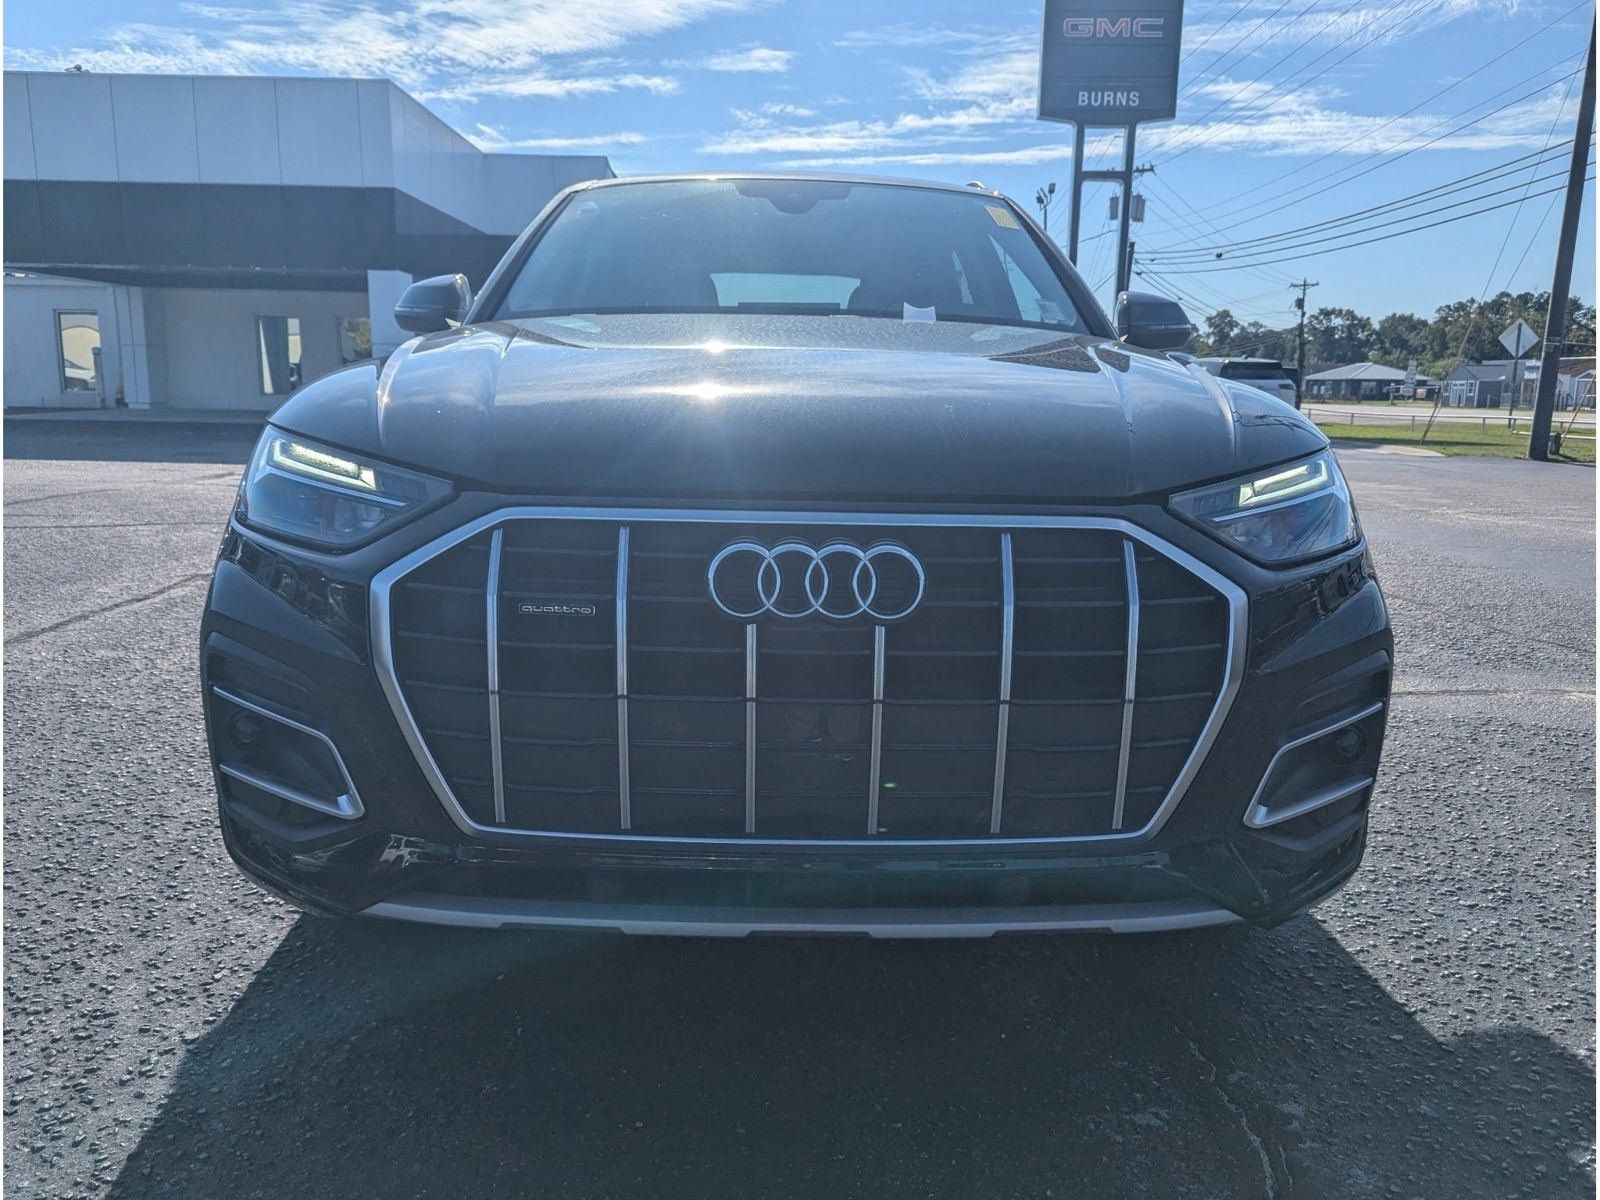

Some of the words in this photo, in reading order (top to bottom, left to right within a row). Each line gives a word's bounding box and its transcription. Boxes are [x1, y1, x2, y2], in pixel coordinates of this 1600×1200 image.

[1063, 18, 1164, 37] GMC
[1078, 91, 1140, 107] BURNS
[520, 604, 593, 615] quattro
